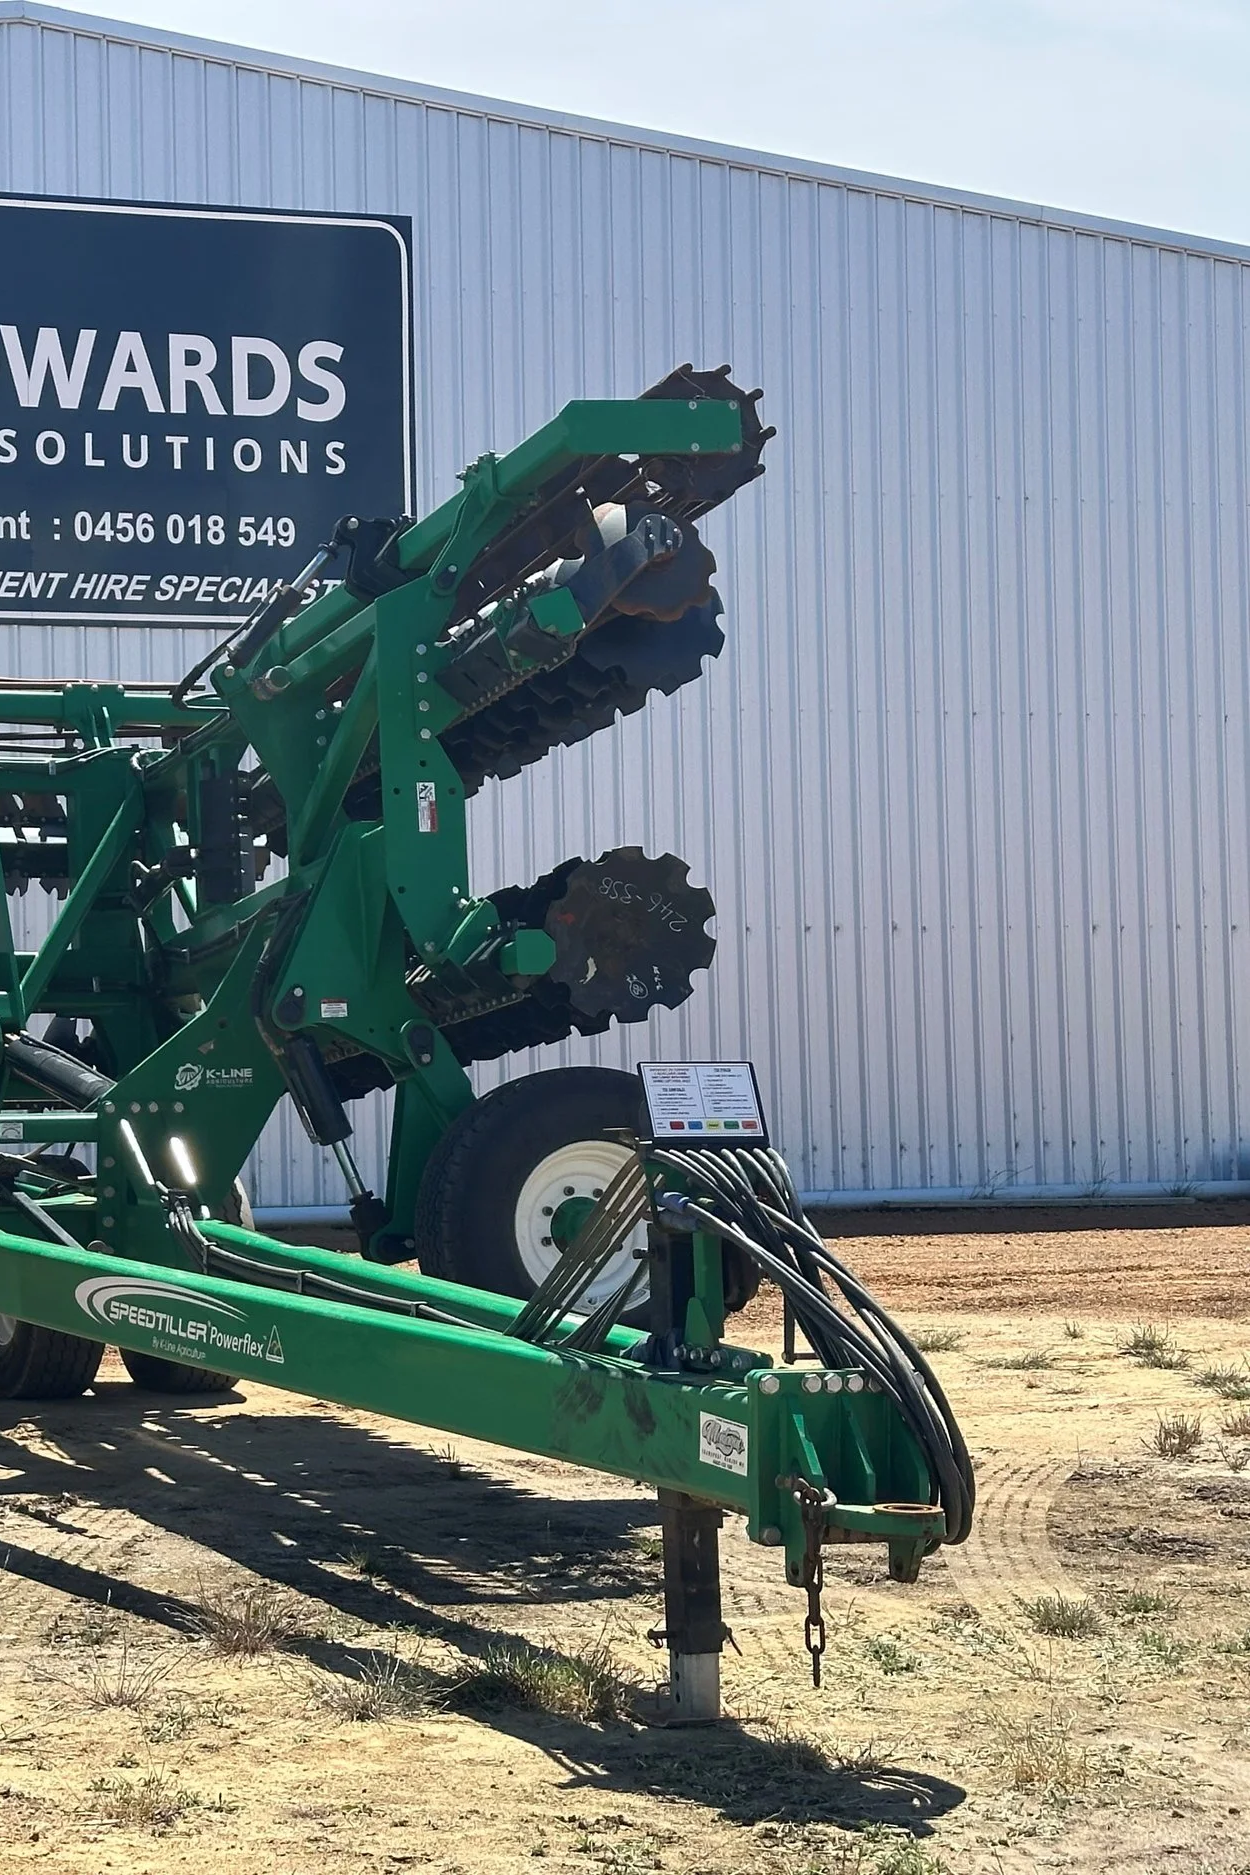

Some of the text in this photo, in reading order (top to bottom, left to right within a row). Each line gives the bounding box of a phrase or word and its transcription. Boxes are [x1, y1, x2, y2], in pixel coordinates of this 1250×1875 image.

[73, 511, 155, 543] 0456
[165, 514, 226, 545] 018
[237, 516, 296, 547] 549
[70, 573, 151, 601] HIRE
[205, 1068, 253, 1079] K-LINE
[176, 1343, 207, 1360] Agriculture
[209, 1325, 265, 1359] Powerflex
